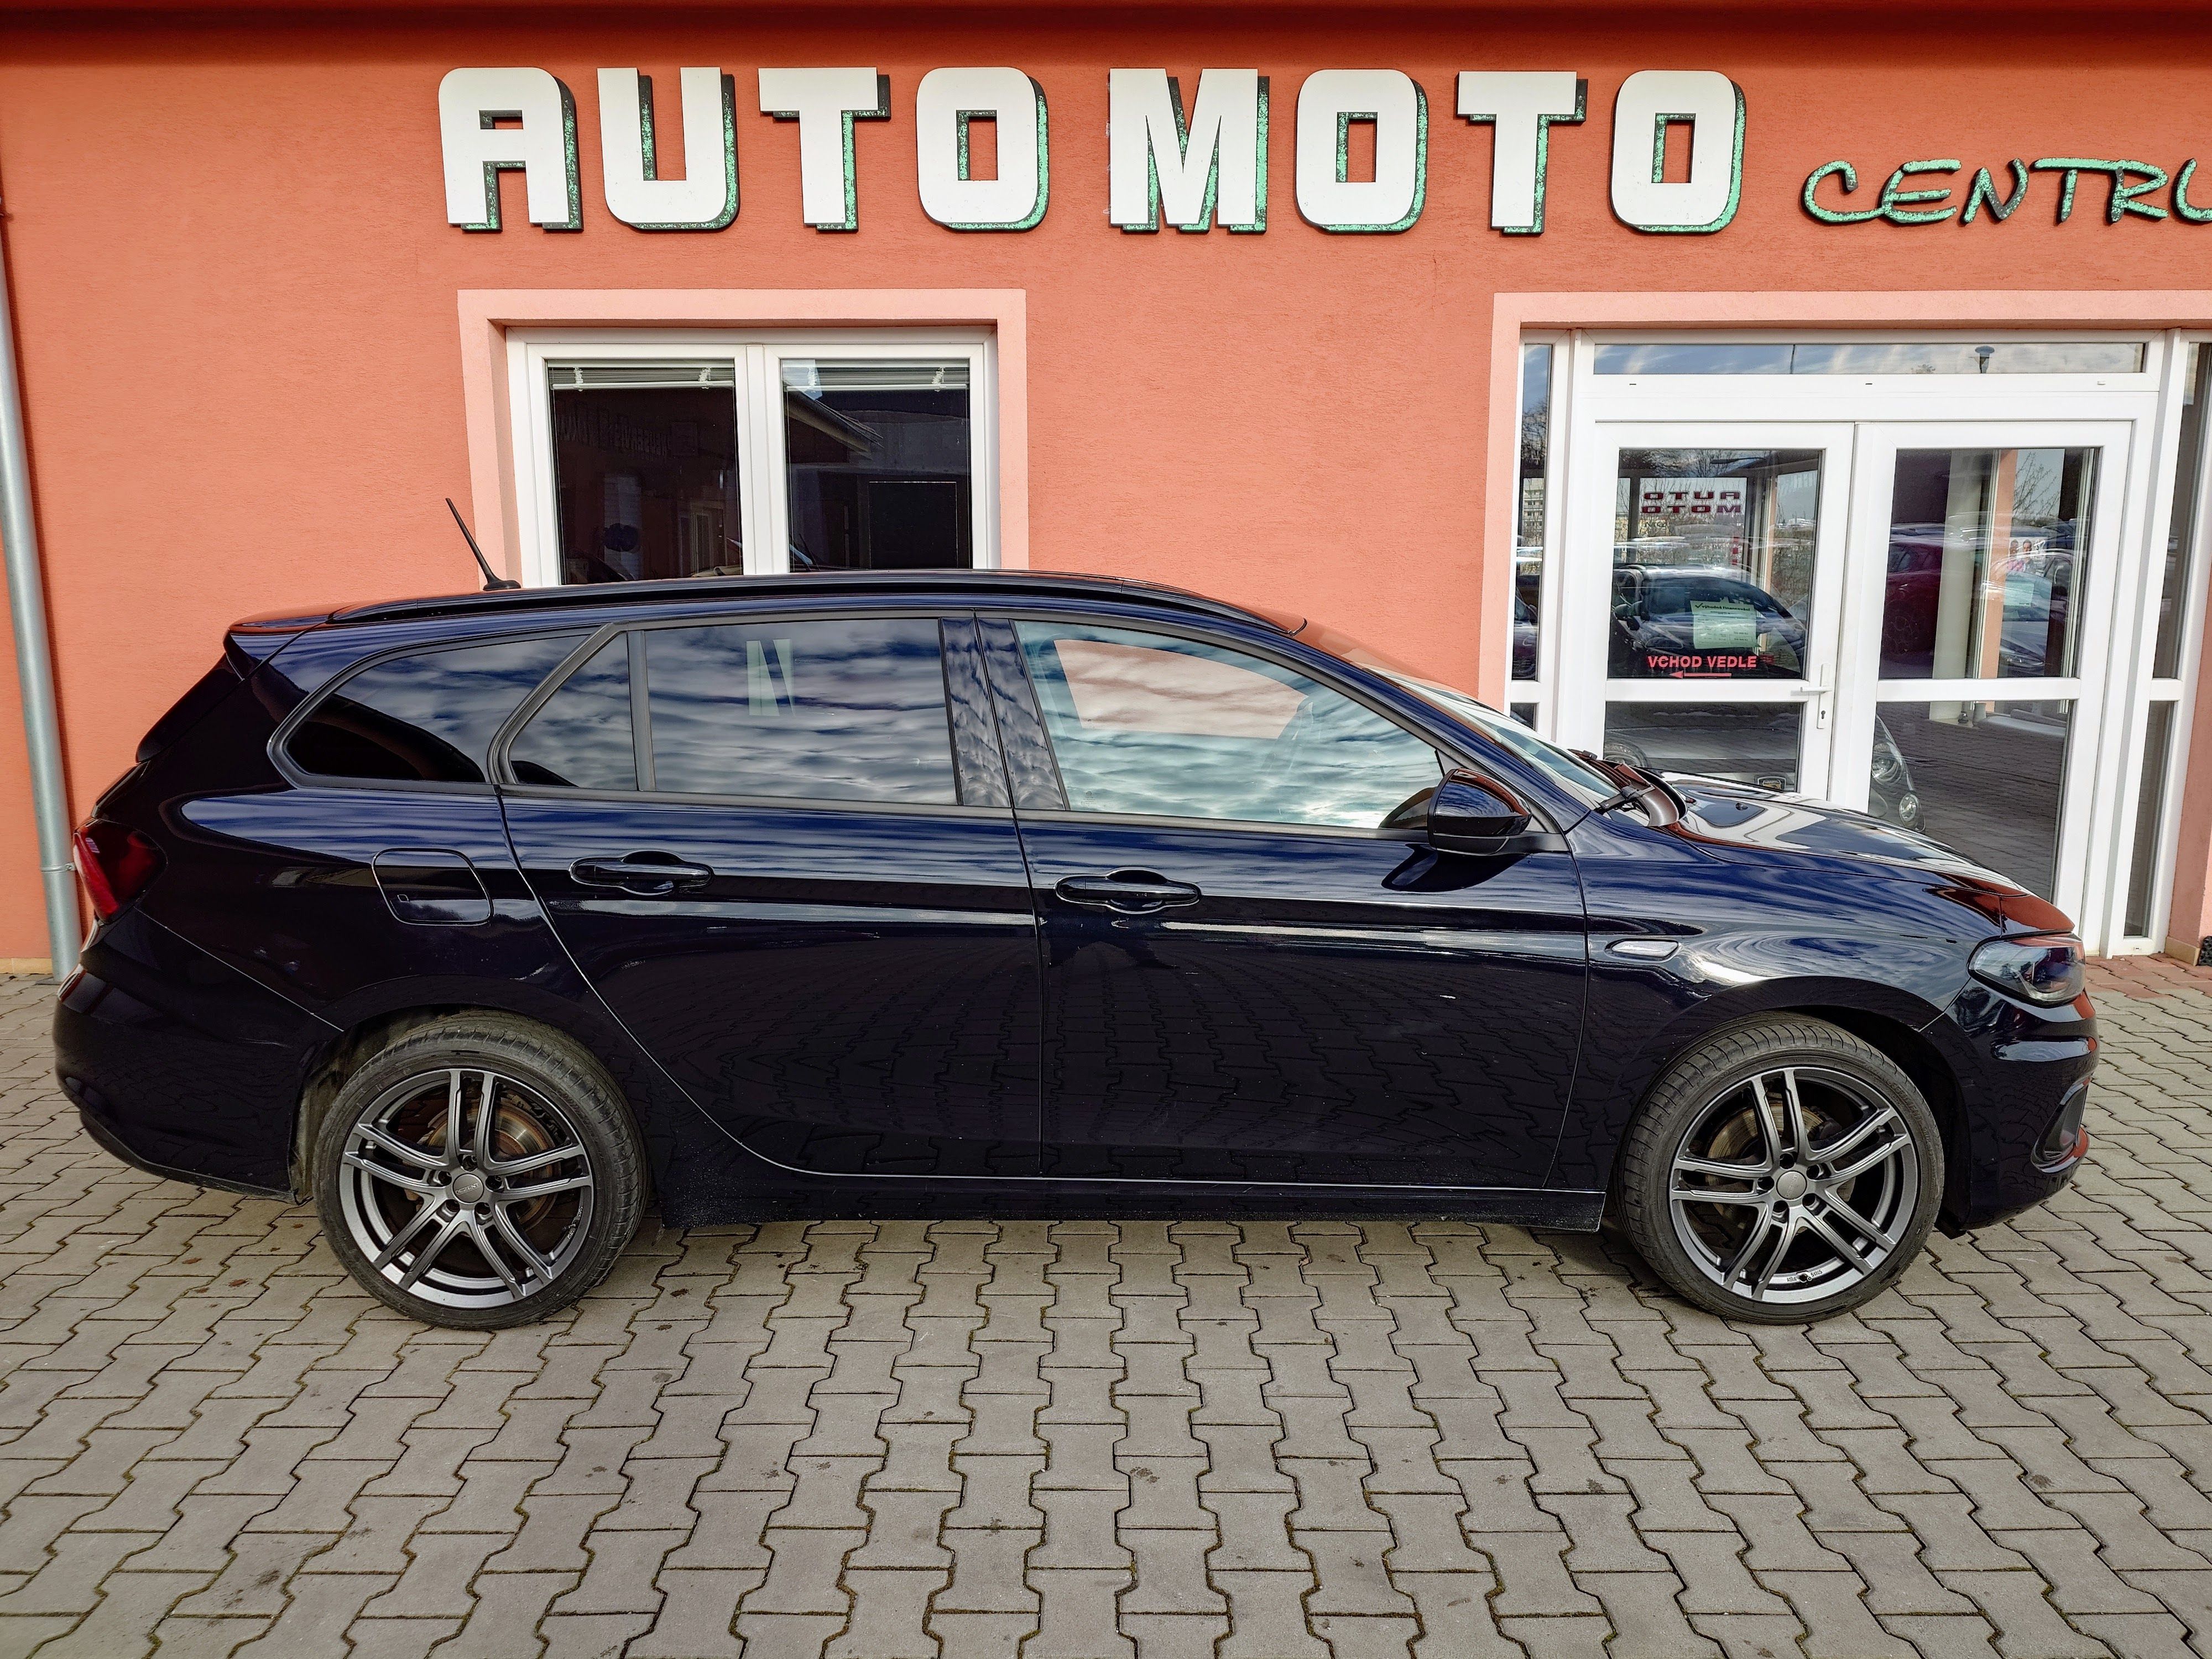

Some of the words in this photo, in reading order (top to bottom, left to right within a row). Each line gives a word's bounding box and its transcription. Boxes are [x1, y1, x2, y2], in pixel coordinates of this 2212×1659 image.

[439, 67, 1048, 232] AUTO
[1109, 68, 1746, 233] MOTO
[1647, 655, 1702, 668] VCHOD
[1707, 655, 1757, 668] VEDLE
